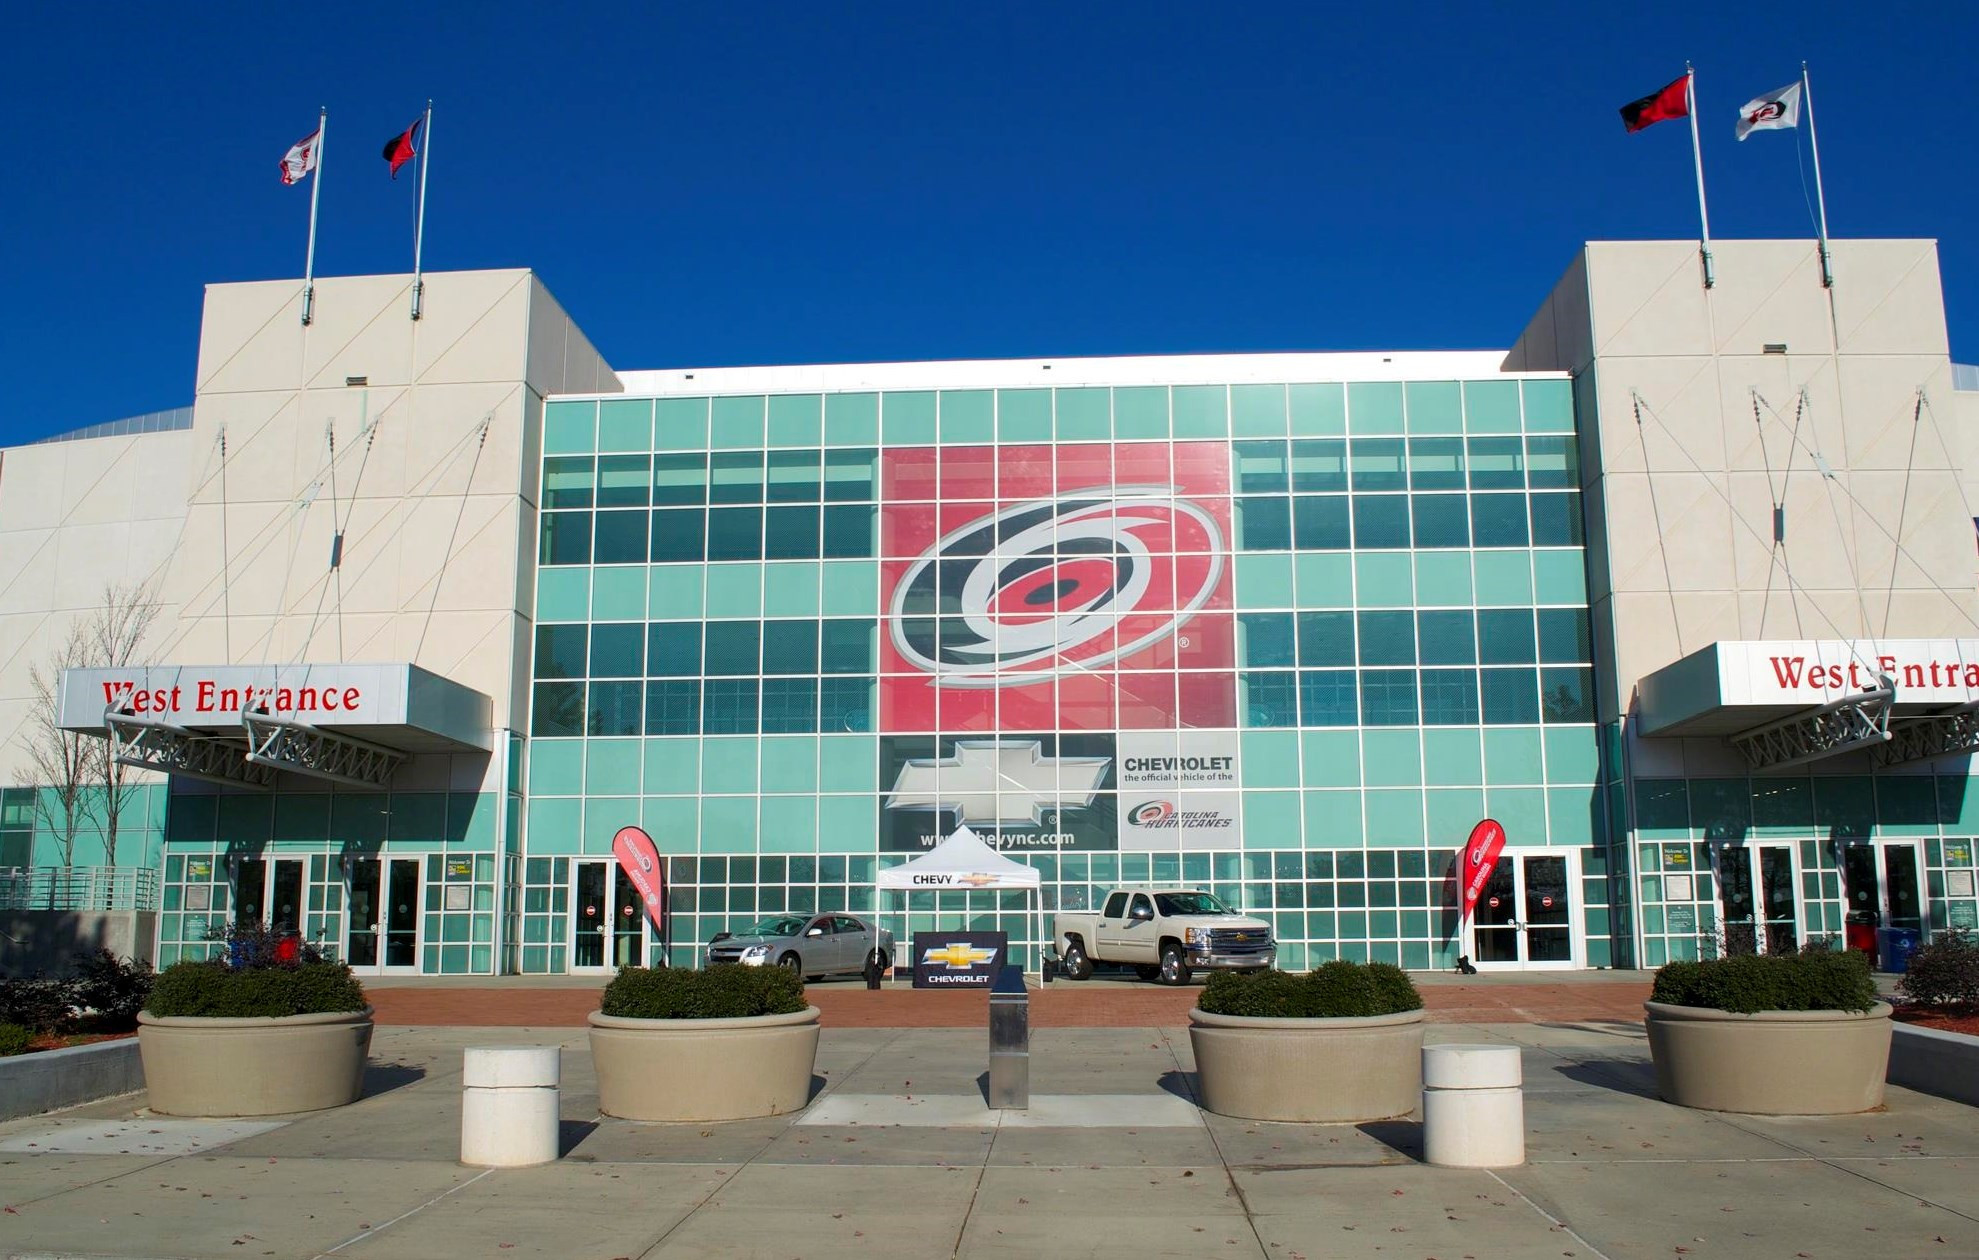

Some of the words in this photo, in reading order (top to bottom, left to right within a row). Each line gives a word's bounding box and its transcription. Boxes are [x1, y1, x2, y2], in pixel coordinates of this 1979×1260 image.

[1769, 656, 1862, 689] West
[1124, 757, 1232, 771] CHEVROLET
[1124, 773, 1139, 782] the
[1141, 773, 1171, 782] official
[1207, 772, 1216, 780] of
[1218, 772, 1233, 780] the
[913, 875, 952, 885] CHEVY
